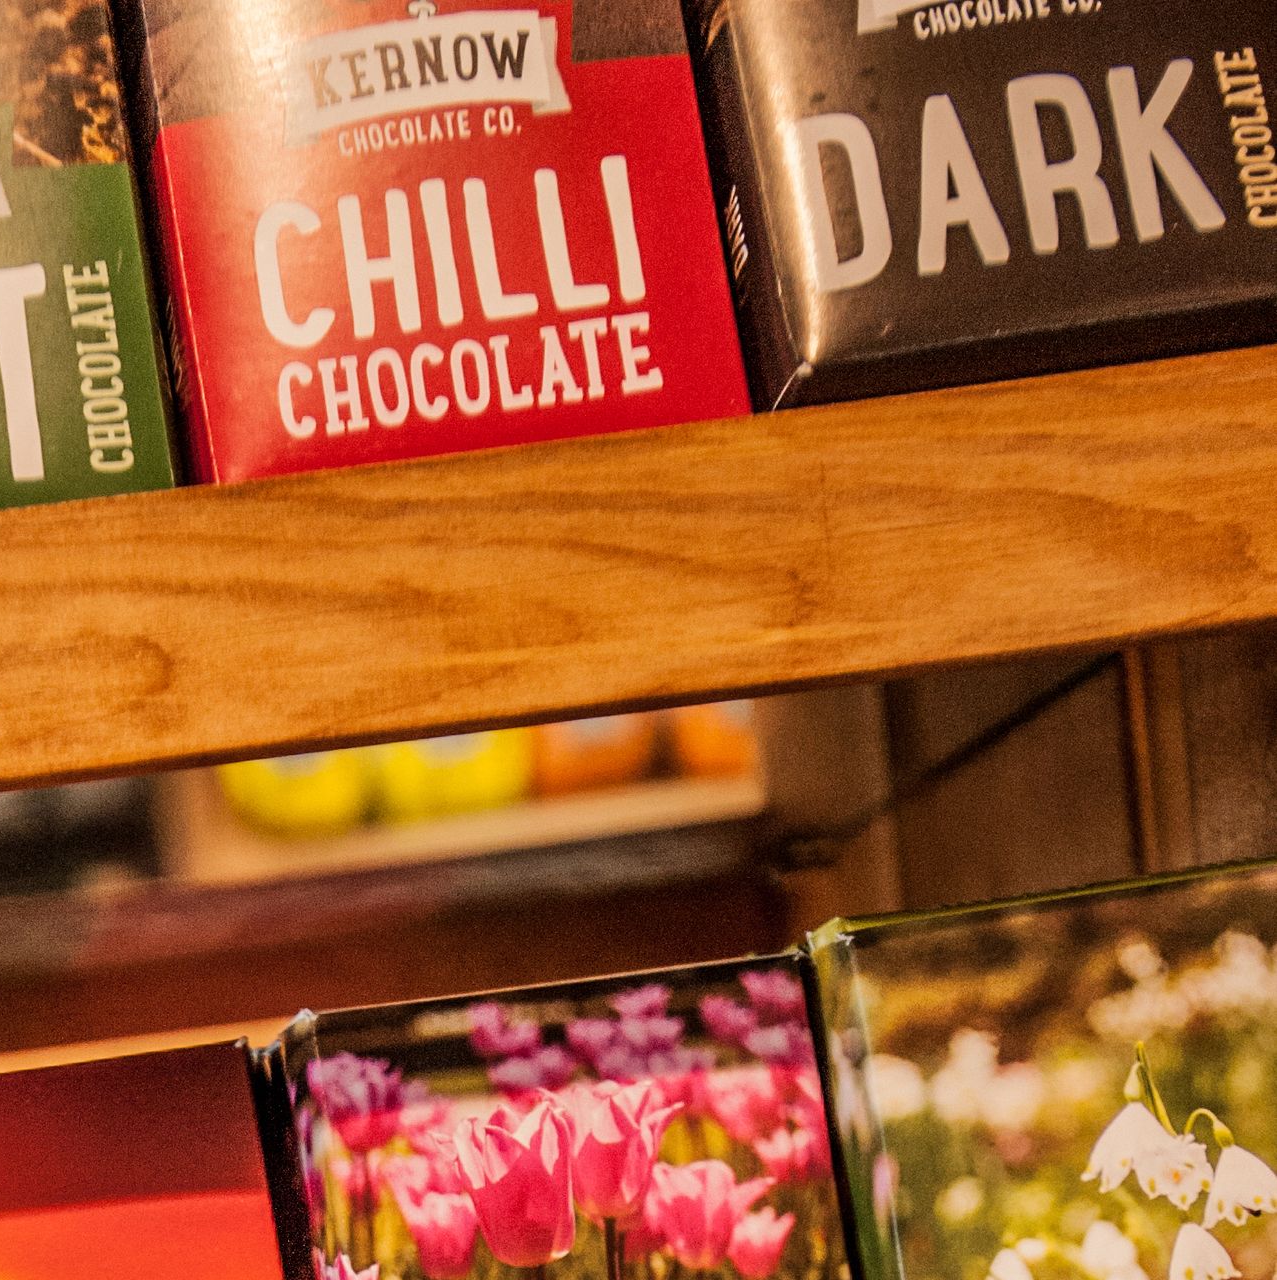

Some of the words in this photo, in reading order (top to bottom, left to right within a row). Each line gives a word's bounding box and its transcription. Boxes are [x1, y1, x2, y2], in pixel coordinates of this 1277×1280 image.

[306, 29, 530, 110] KERNOW
[338, 109, 471, 157] CHOCOLATE
[483, 105, 522, 137] CO.
[1214, 46, 1277, 229] CHOCOLATE
[252, 154, 648, 348] CHILLI
[724, 183, 749, 280] DARK
[794, 57, 1227, 292] DARK
[62, 260, 135, 473] CHOCOLATE
[276, 311, 665, 439] CHOCOLATE
